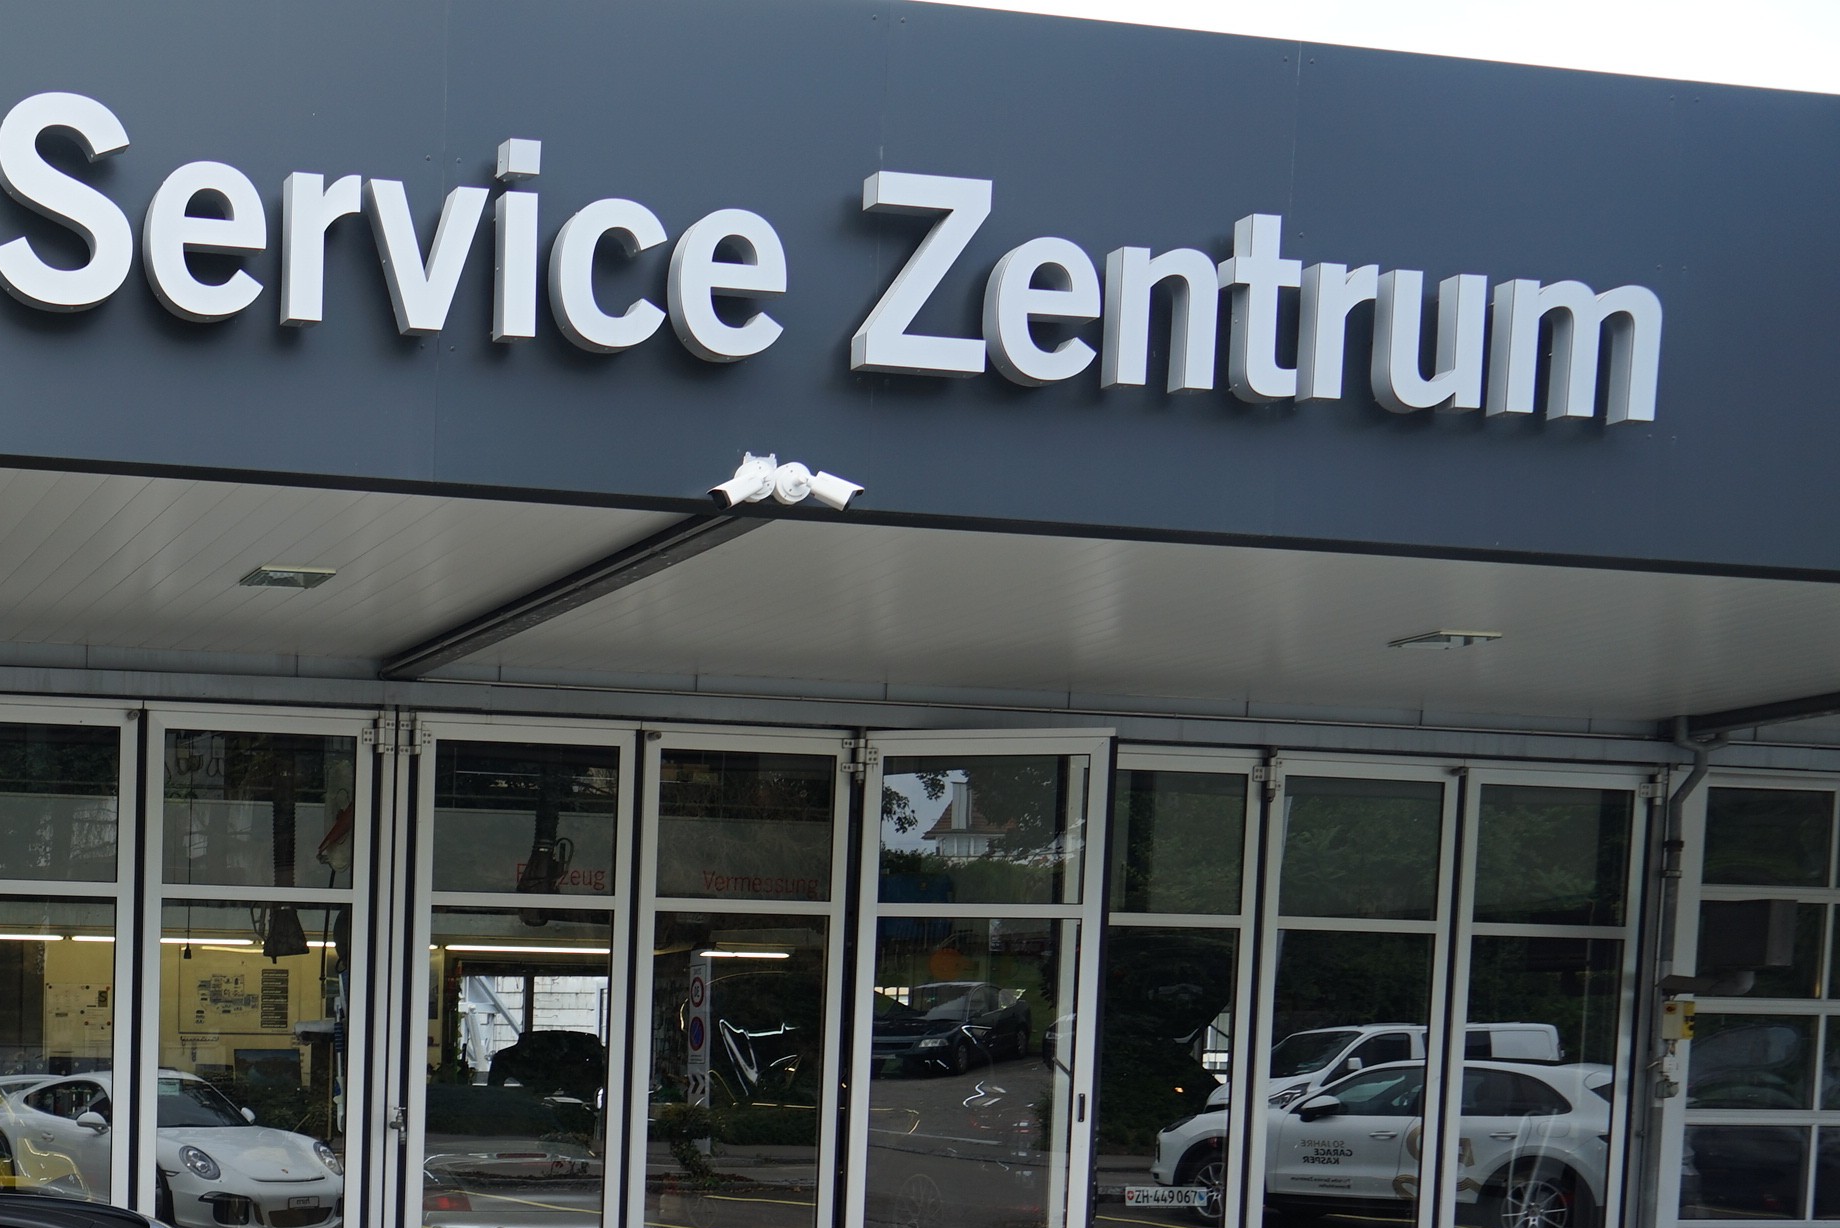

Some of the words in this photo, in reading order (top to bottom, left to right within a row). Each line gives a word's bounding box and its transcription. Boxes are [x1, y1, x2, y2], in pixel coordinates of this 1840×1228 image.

[850, 170, 1663, 426] Zentrum
[515, 862, 607, 891] Fzeug
[702, 870, 820, 899] Vermessung
